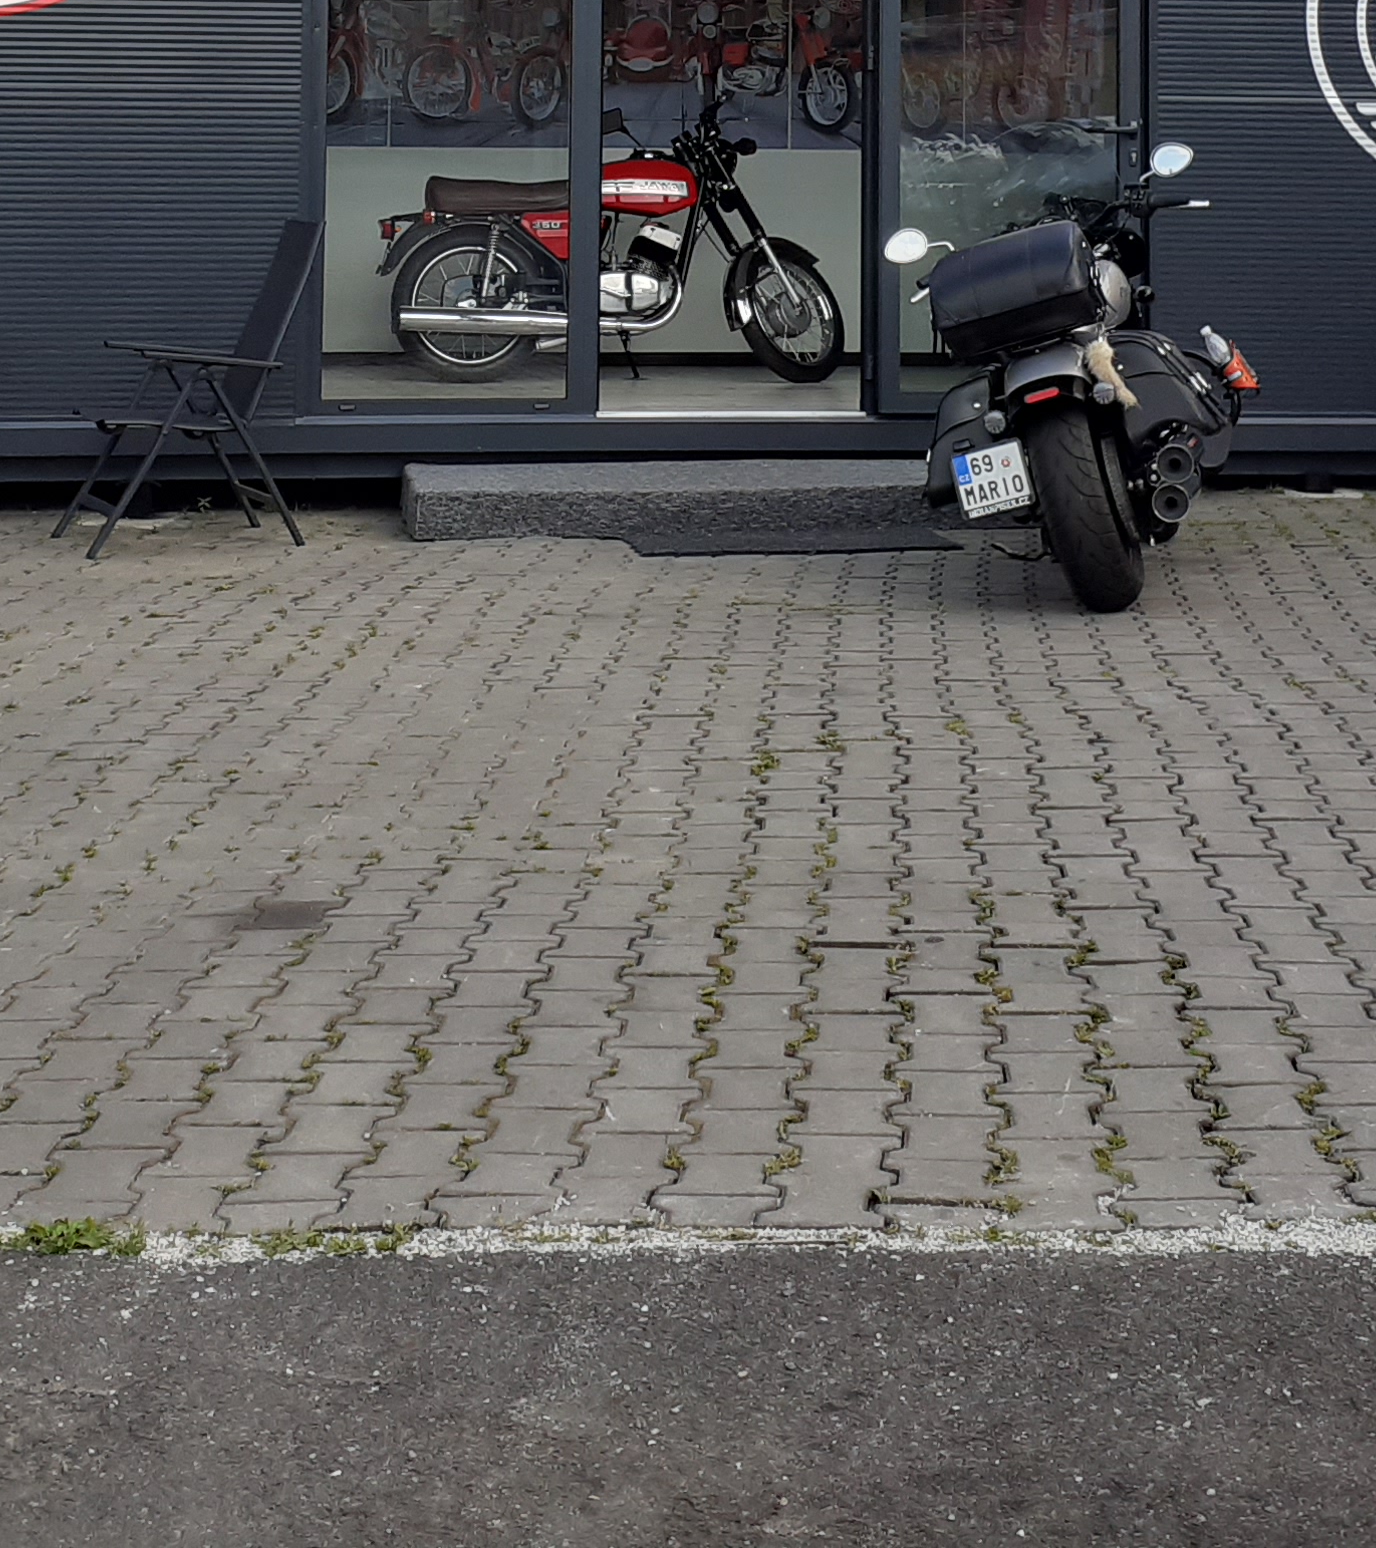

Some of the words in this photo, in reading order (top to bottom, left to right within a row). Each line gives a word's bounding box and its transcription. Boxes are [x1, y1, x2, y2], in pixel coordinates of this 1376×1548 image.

[532, 221, 561, 229] 350
[970, 454, 994, 476] 69
[958, 474, 971, 483] CZ
[964, 474, 1024, 506] MARIO
